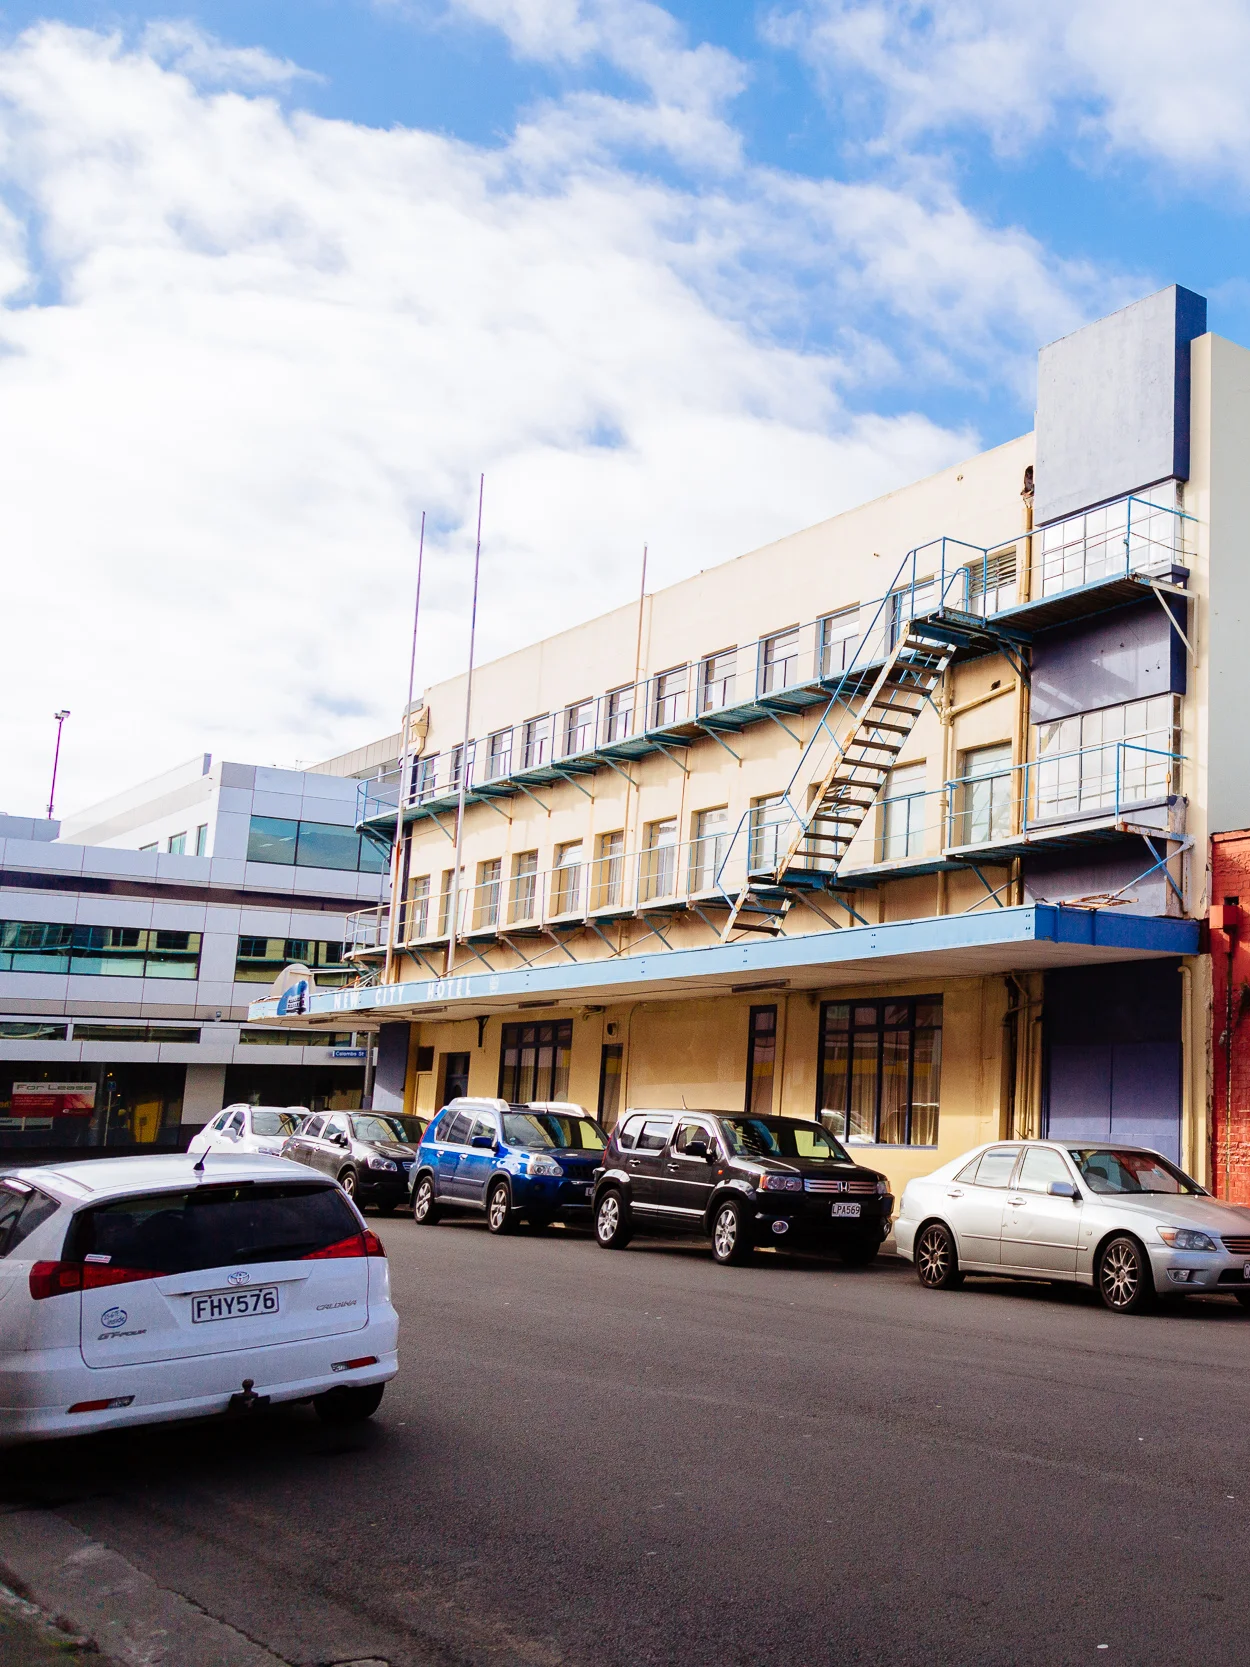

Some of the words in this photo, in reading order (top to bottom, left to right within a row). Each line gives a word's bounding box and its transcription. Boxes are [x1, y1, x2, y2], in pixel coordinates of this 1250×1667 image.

[334, 991, 360, 1009] NEW
[375, 986, 404, 1004] CITY
[427, 978, 471, 999] HOTEL
[832, 1205, 860, 1215] LPA569
[196, 1291, 275, 1319] FHY576
